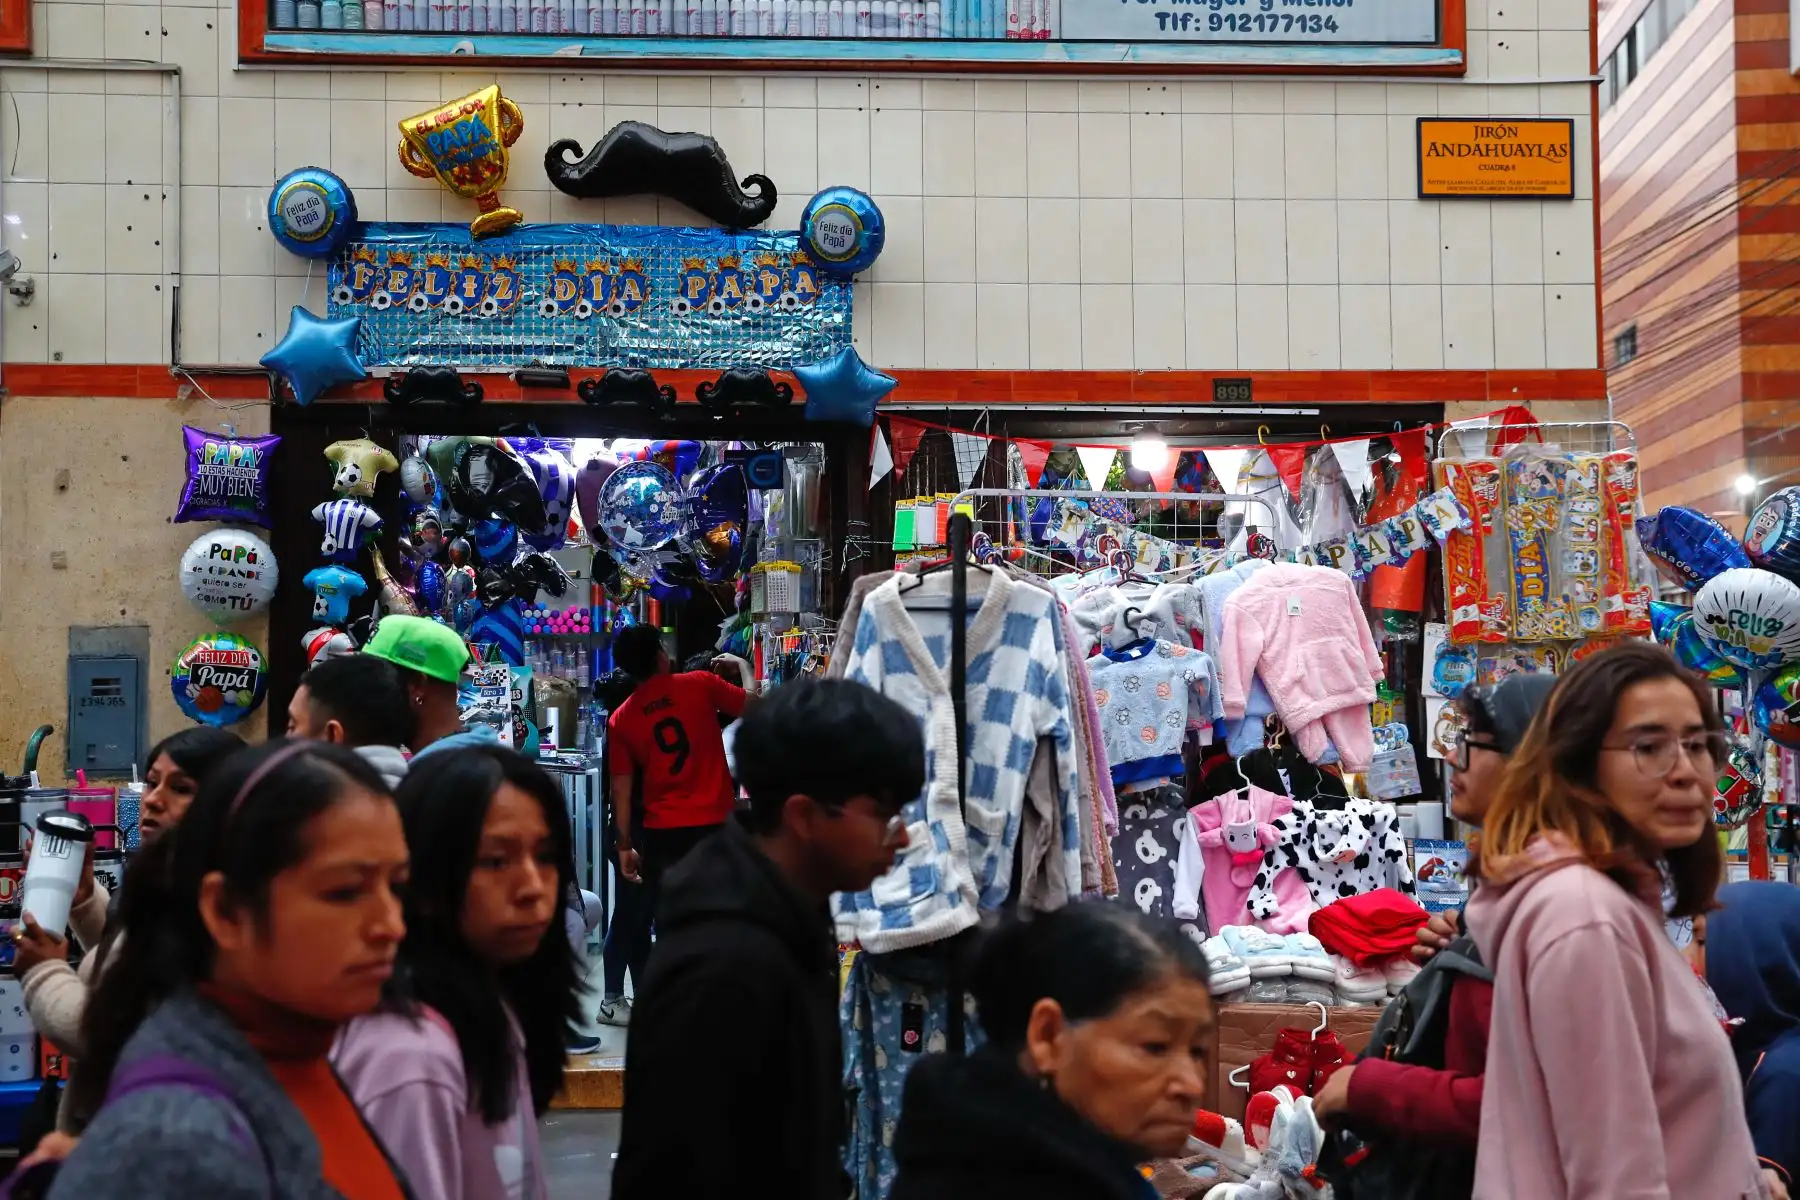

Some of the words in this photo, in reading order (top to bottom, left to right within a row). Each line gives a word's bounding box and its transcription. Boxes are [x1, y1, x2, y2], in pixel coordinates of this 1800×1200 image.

[1154, 12, 1201, 32] Tlf:
[1208, 13, 1339, 33] 912177134
[416, 119, 433, 134] EL
[435, 99, 485, 126] MEJOR
[1473, 123, 1518, 141] JIRÓN
[1426, 141, 1568, 163] ANDAHUAYLAS
[1478, 163, 1510, 172] CUADRA
[286, 202, 306, 217] Feliz
[820, 221, 838, 233] Feliz
[352, 264, 513, 299] FELIZ
[1216, 386, 1250, 399] 899
[200, 465, 208, 474] LO
[208, 466, 226, 476] ESTAS
[226, 468, 256, 478] HACIENDO
[200, 474, 227, 496] MUY
[227, 477, 255, 498] BIEN
[192, 565, 203, 573] de
[200, 652, 227, 664] FELIZ
[198, 665, 250, 691] Papá
[654, 716, 690, 775] 9
